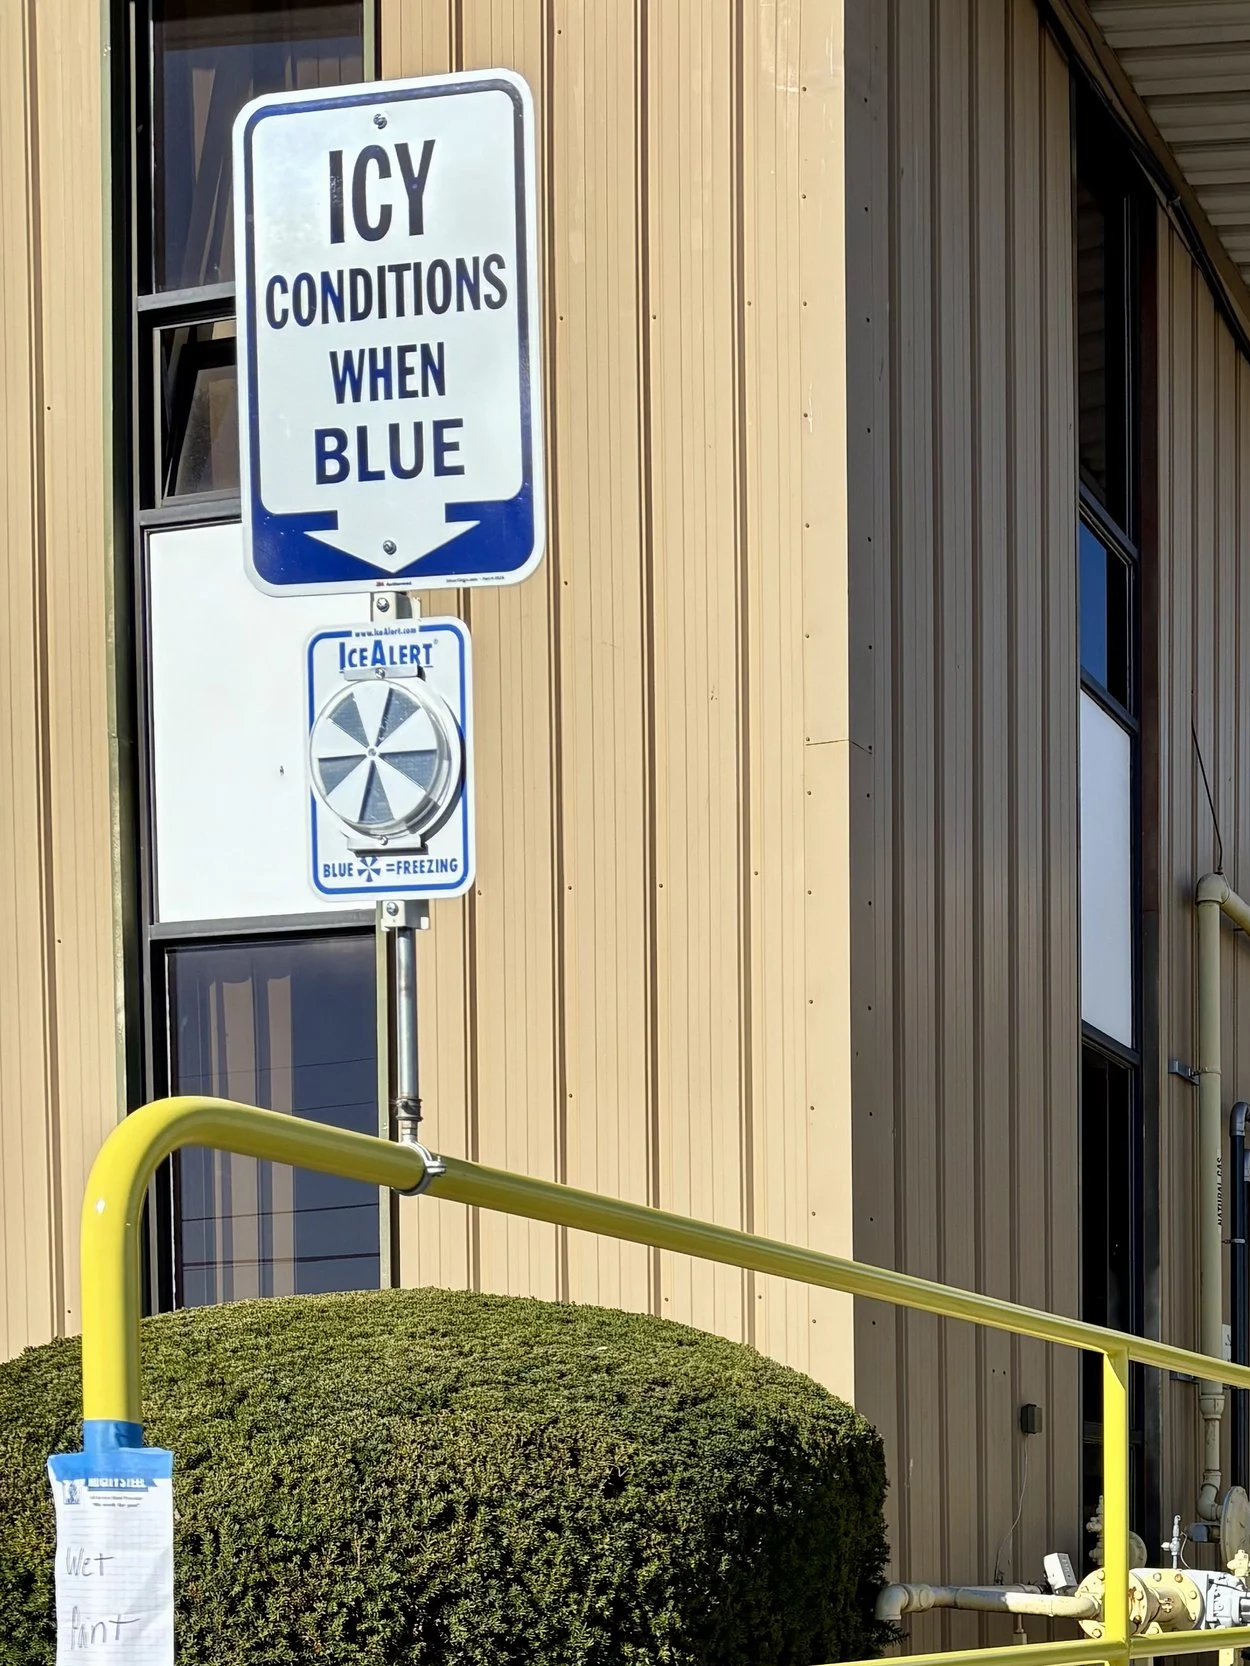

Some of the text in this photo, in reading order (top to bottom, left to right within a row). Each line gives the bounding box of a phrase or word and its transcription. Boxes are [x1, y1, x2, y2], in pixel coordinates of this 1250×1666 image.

[328, 139, 436, 244] ICY
[266, 253, 508, 330] CONDITIONS
[329, 341, 447, 404] WHEN
[314, 418, 466, 486] BLUE
[322, 862, 354, 878] BLUE
[65, 1546, 116, 1577] Wet
[70, 1605, 141, 1651] Paint
